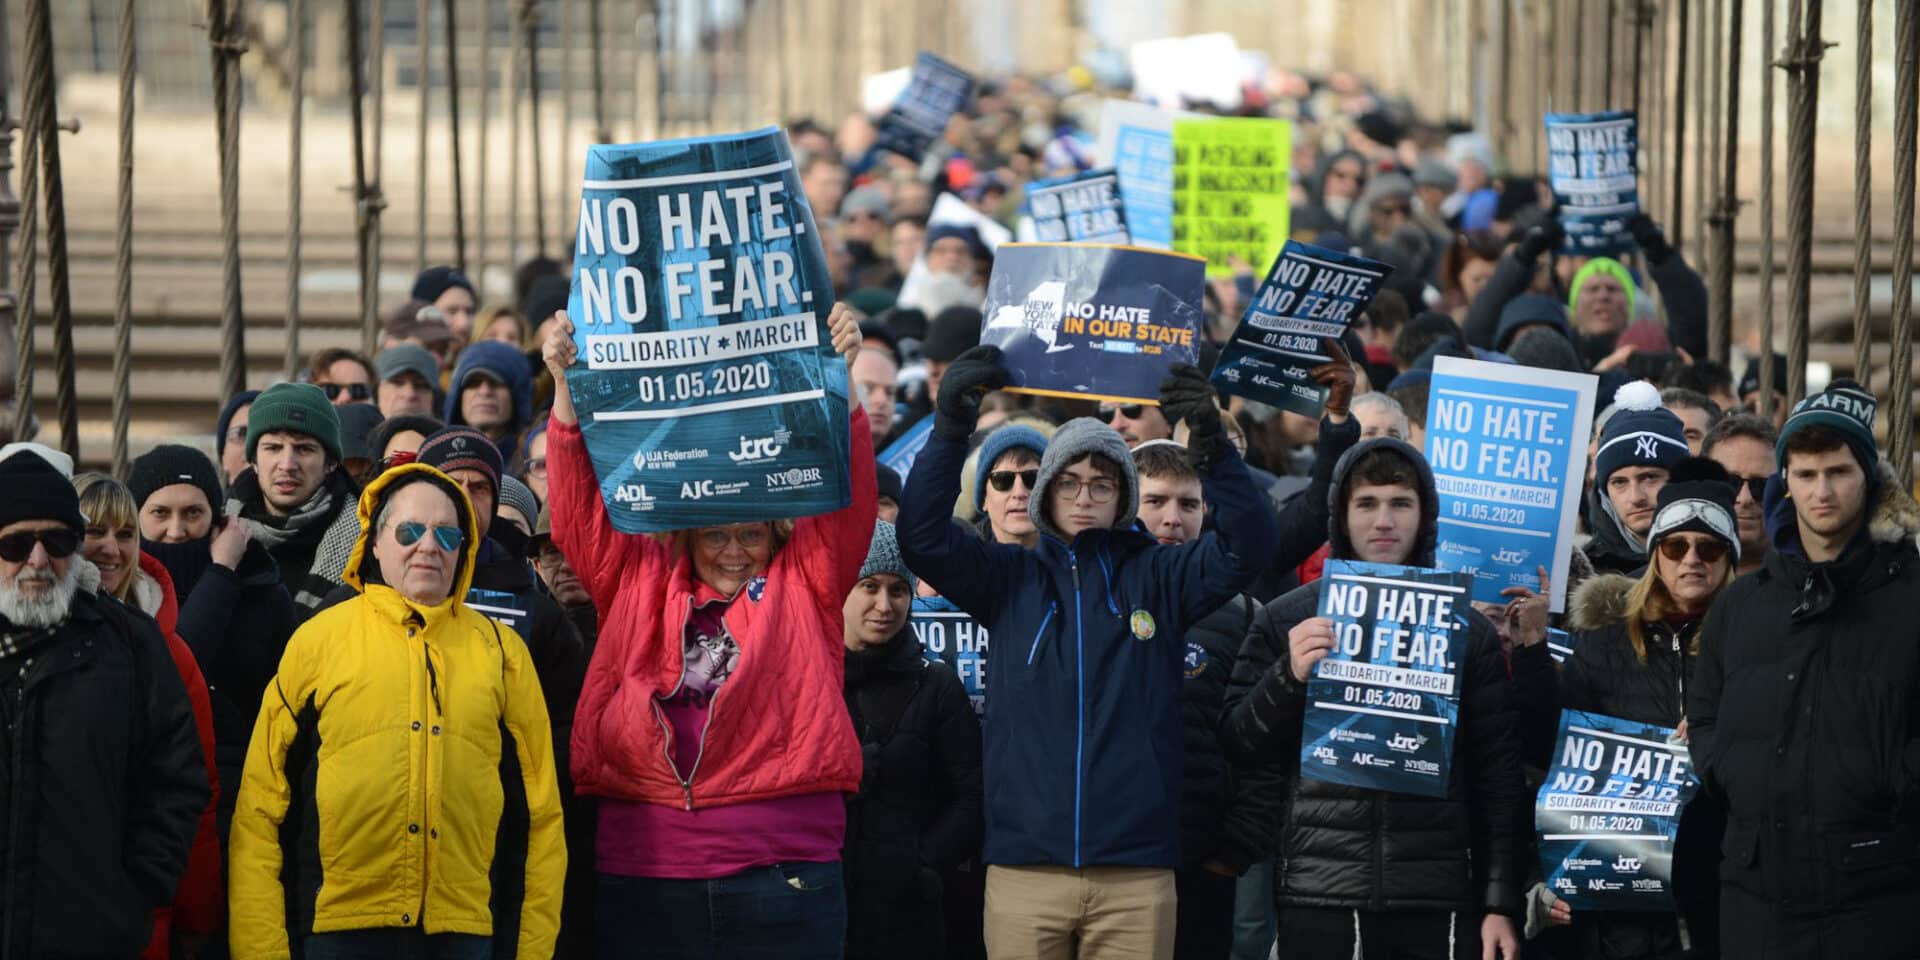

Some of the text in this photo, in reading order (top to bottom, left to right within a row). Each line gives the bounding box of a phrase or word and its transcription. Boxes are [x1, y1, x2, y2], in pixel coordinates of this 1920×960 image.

[578, 181, 806, 255] NO HATE.
[580, 253, 814, 324] NO FEAR.
[1273, 259, 1310, 287] NO
[1311, 269, 1371, 300] HATE.
[1066, 302, 1150, 324] NO HATE
[1258, 286, 1354, 322] NO FEAR.
[1064, 317, 1193, 346] IN OUR STATE
[1253, 313, 1341, 335] SOLIDARITY MARCH
[593, 320, 807, 364] SOLIDARITY MARCH
[1264, 333, 1318, 351] 01.05.2020
[639, 363, 770, 403] 01.05.2020
[1434, 398, 1564, 445] NO HATE.
[1810, 394, 1877, 429] ARM
[664, 448, 708, 461] Federation
[1432, 436, 1559, 484] NO FEAR.
[680, 480, 714, 500] AJC
[1435, 478, 1550, 505] SOLIDARITY MARCH
[1452, 502, 1526, 525] 01.05.2020
[1327, 583, 1460, 630] NO HATE.
[956, 622, 989, 653] HA
[1372, 627, 1455, 669] FEAR.
[957, 659, 986, 689] FE
[1323, 662, 1448, 689] SOLIDARITY MARCH
[1344, 686, 1421, 710] 01.05.2020
[1562, 736, 1694, 786] NO HATE.
[1552, 772, 1596, 793] NO
[1550, 796, 1671, 813] SOLIDARITY MARCH
[1569, 815, 1643, 831] 01.05.2020
